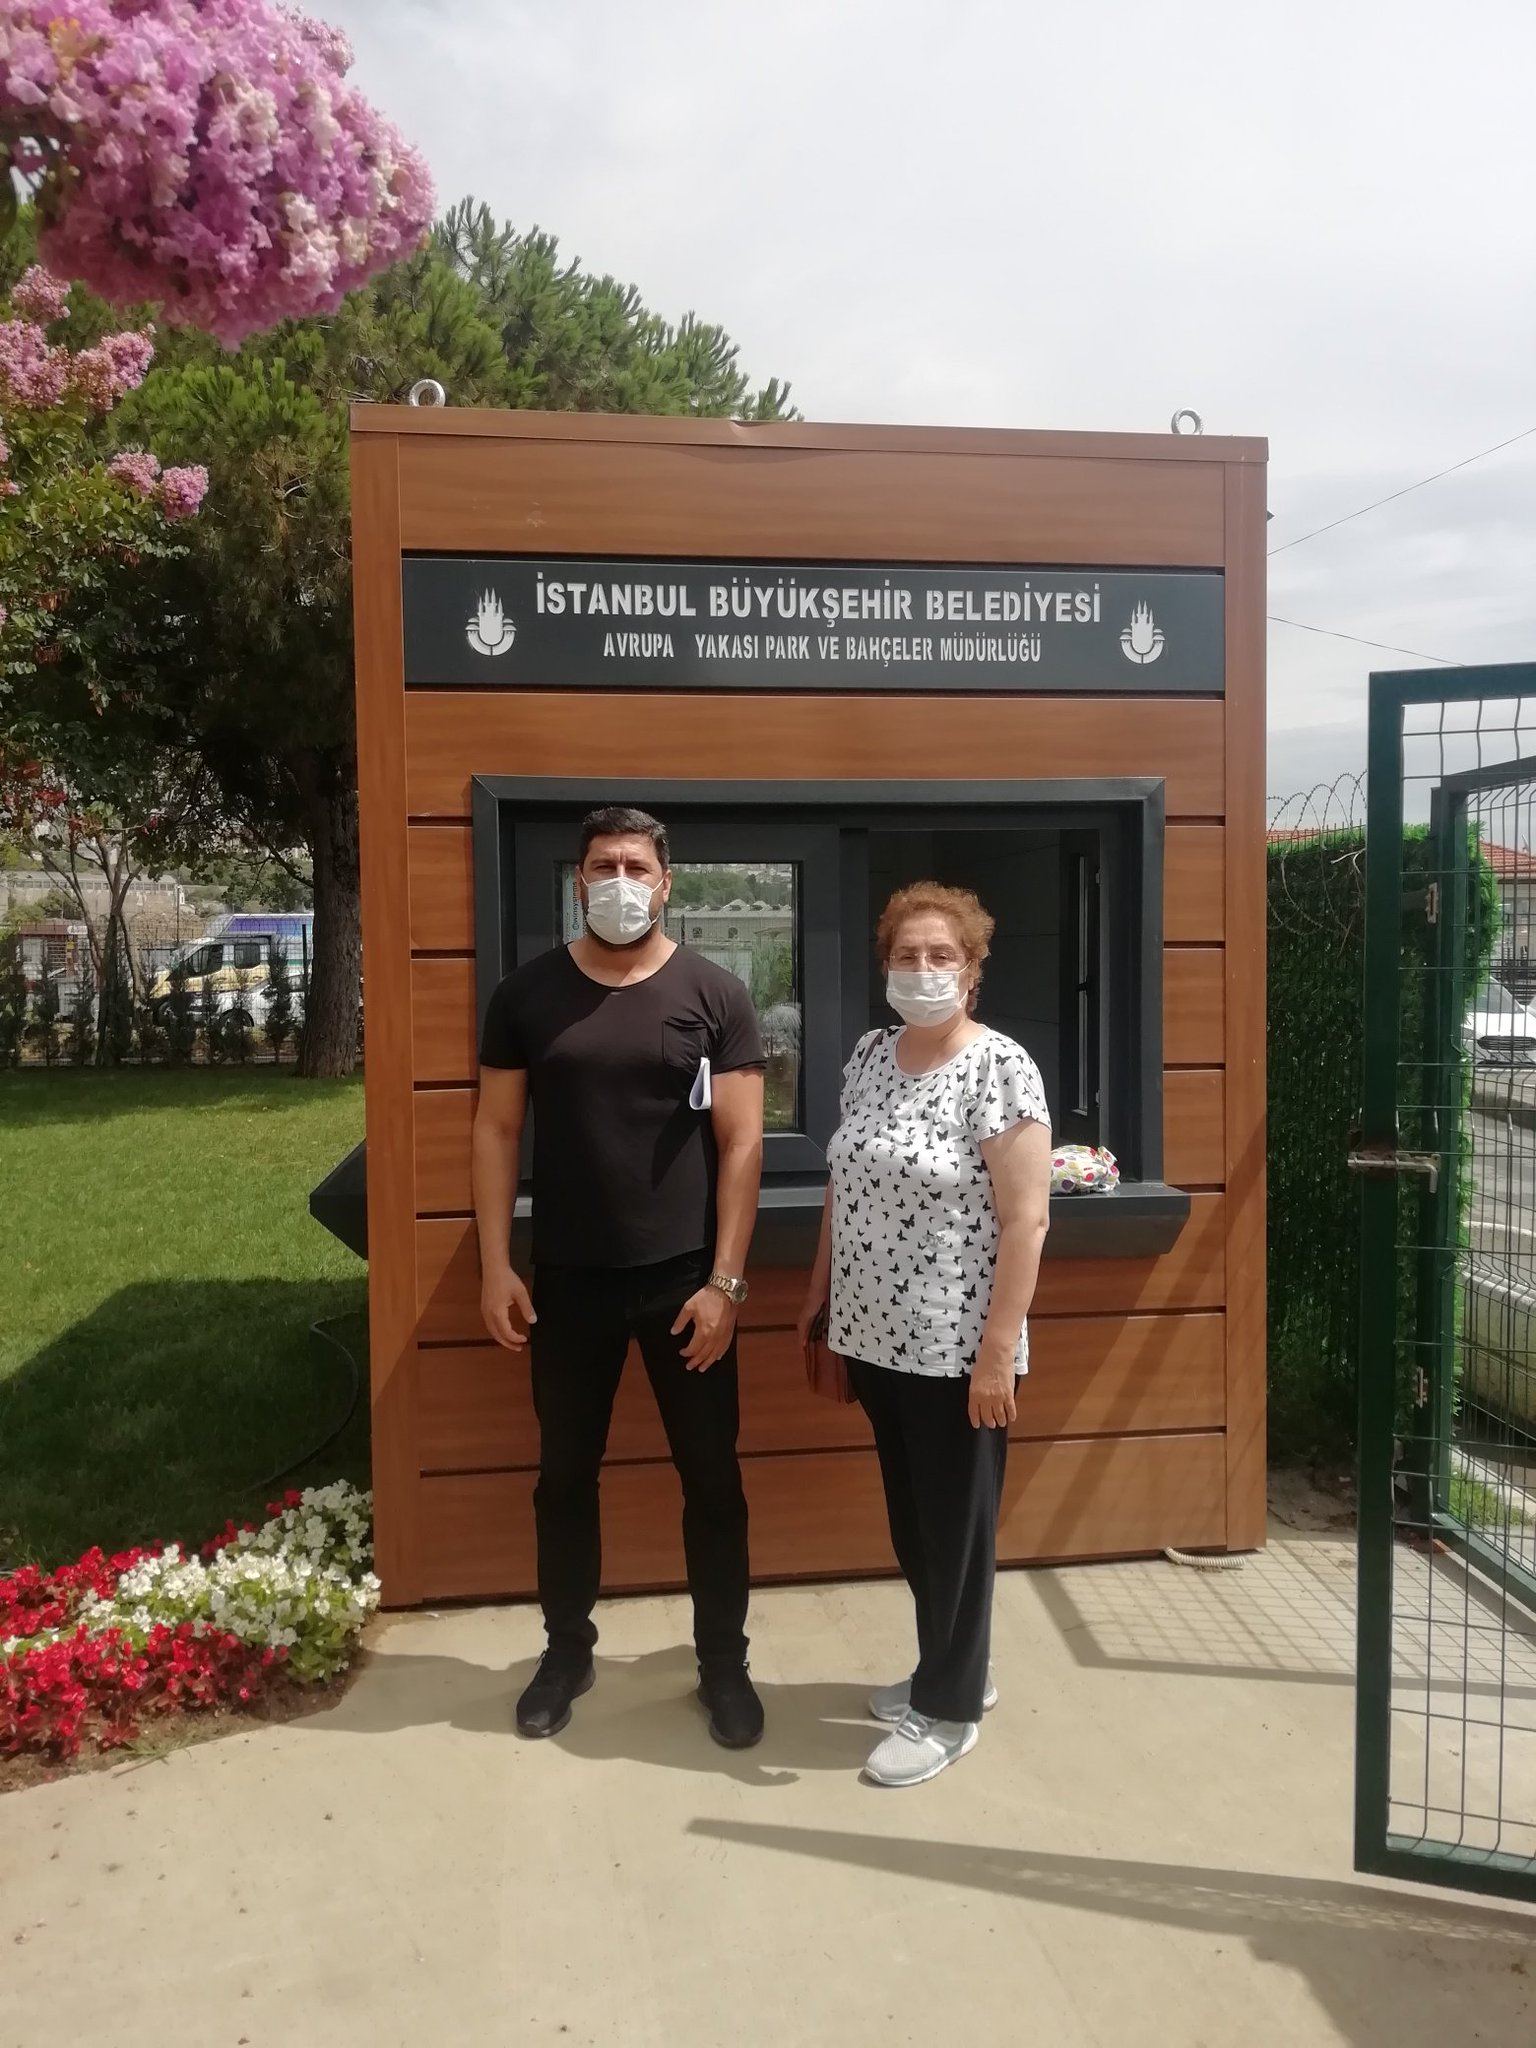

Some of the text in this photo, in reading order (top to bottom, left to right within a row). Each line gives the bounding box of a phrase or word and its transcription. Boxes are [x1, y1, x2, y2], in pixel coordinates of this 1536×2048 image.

[536, 571, 1101, 628] İSTANBUL BÜYÜKŞEHİR BELEDİYESİ
[603, 631, 1041, 668] AVRUPA YAKASI PARK VE BAHÇELER MÜDÜRLÜĞÜ
